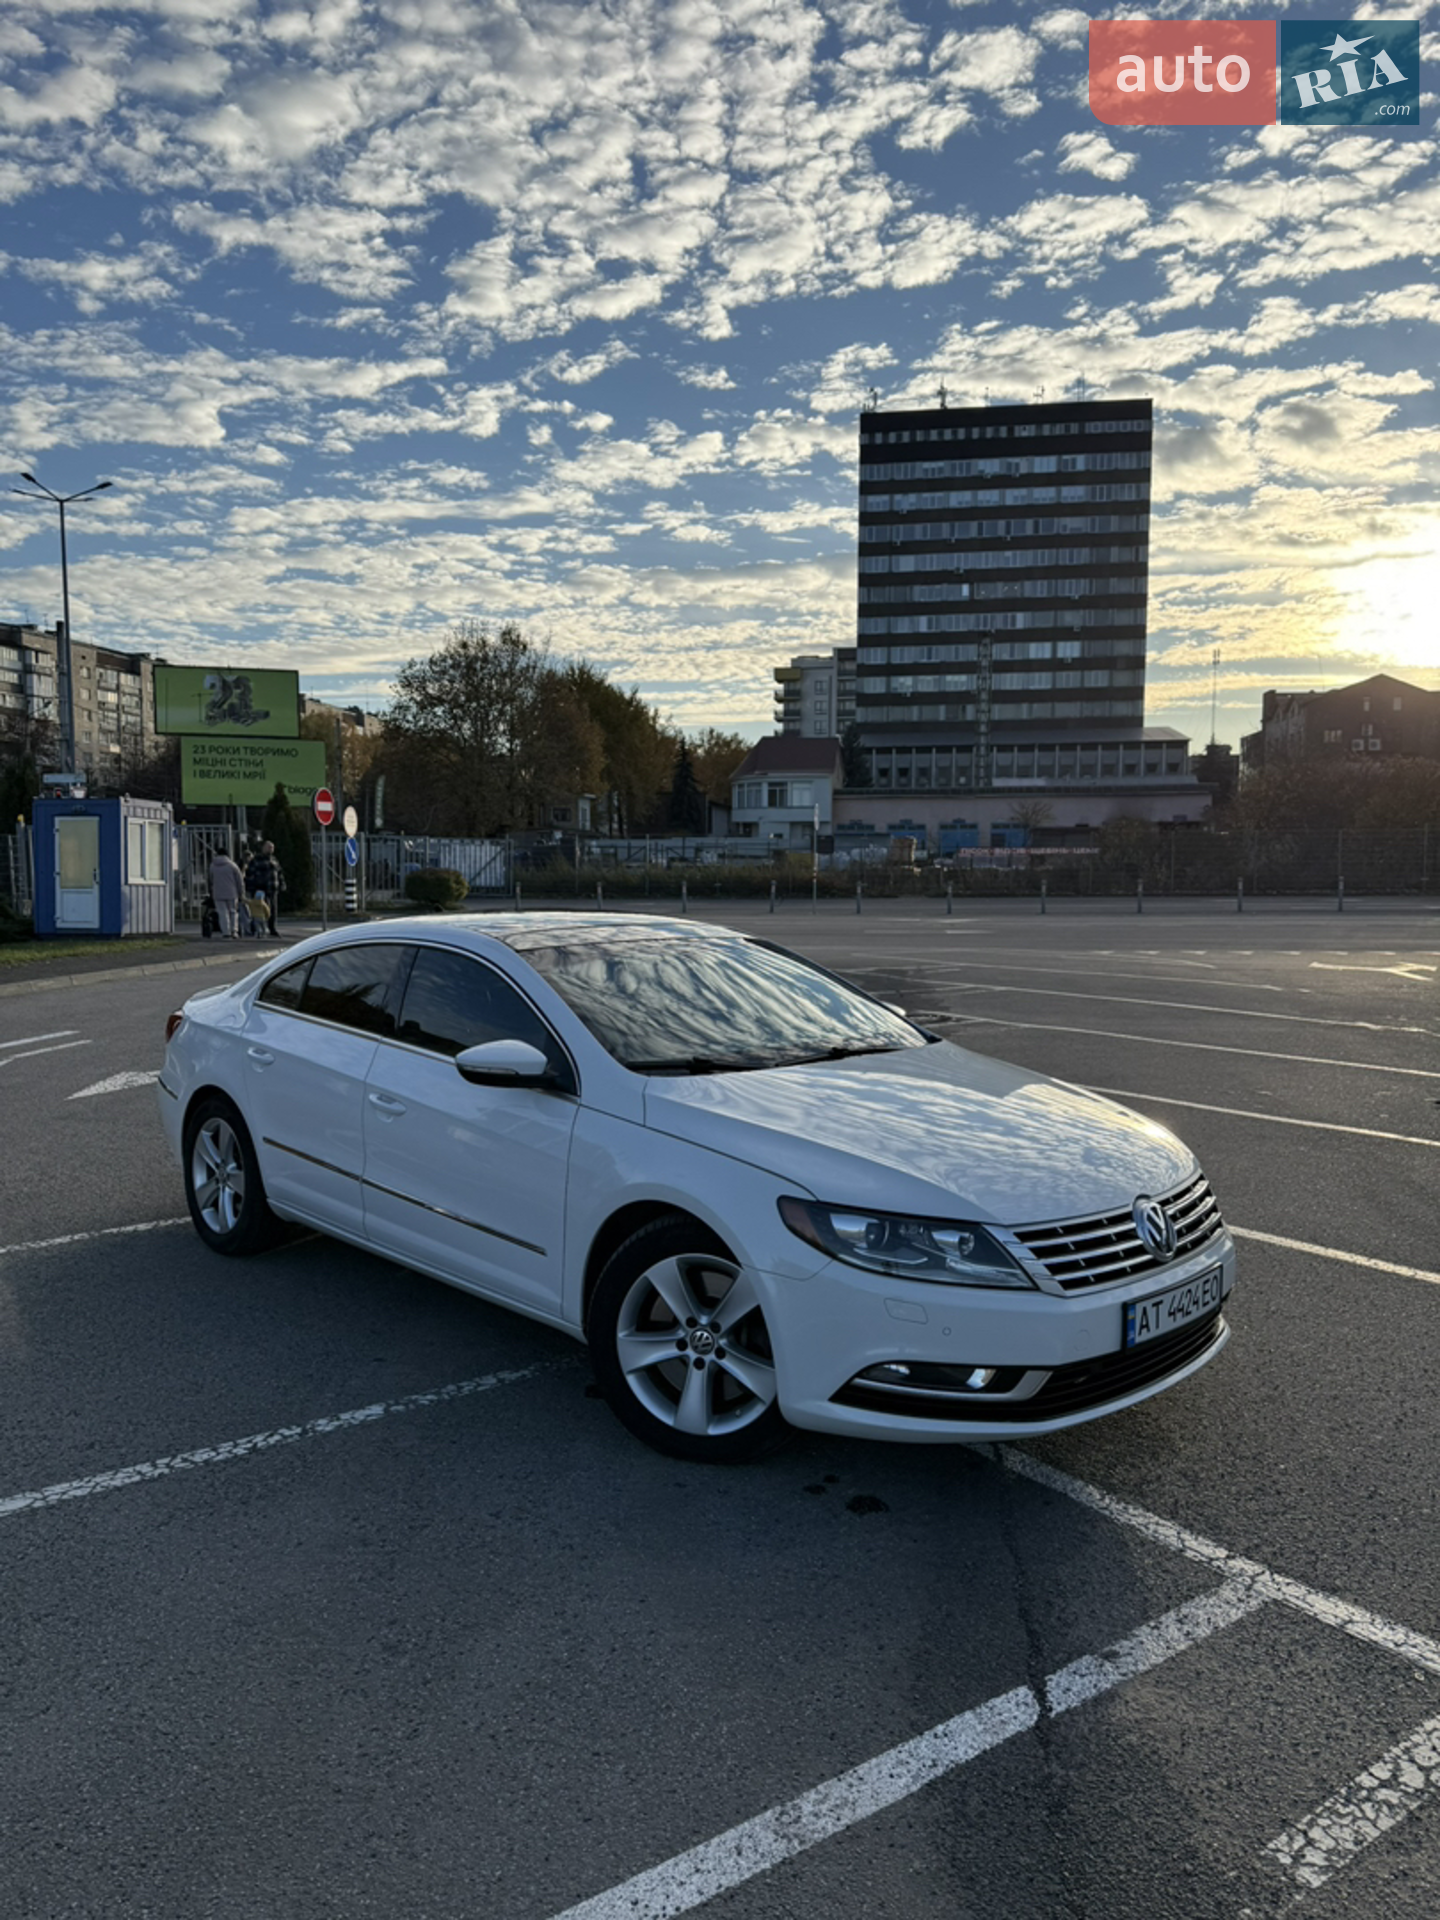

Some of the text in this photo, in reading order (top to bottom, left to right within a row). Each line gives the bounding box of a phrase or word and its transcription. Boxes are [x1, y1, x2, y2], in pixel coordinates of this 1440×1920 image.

[192, 744, 299, 759] 23 РОКИ ТВОРИМО
[193, 757, 264, 768] МІЦНІ СТІНИ
[198, 769, 240, 780] ВЕЛИКІ
[243, 769, 266, 780] МРІЇ
[1138, 1275, 1219, 1336] AT 4424 EO
